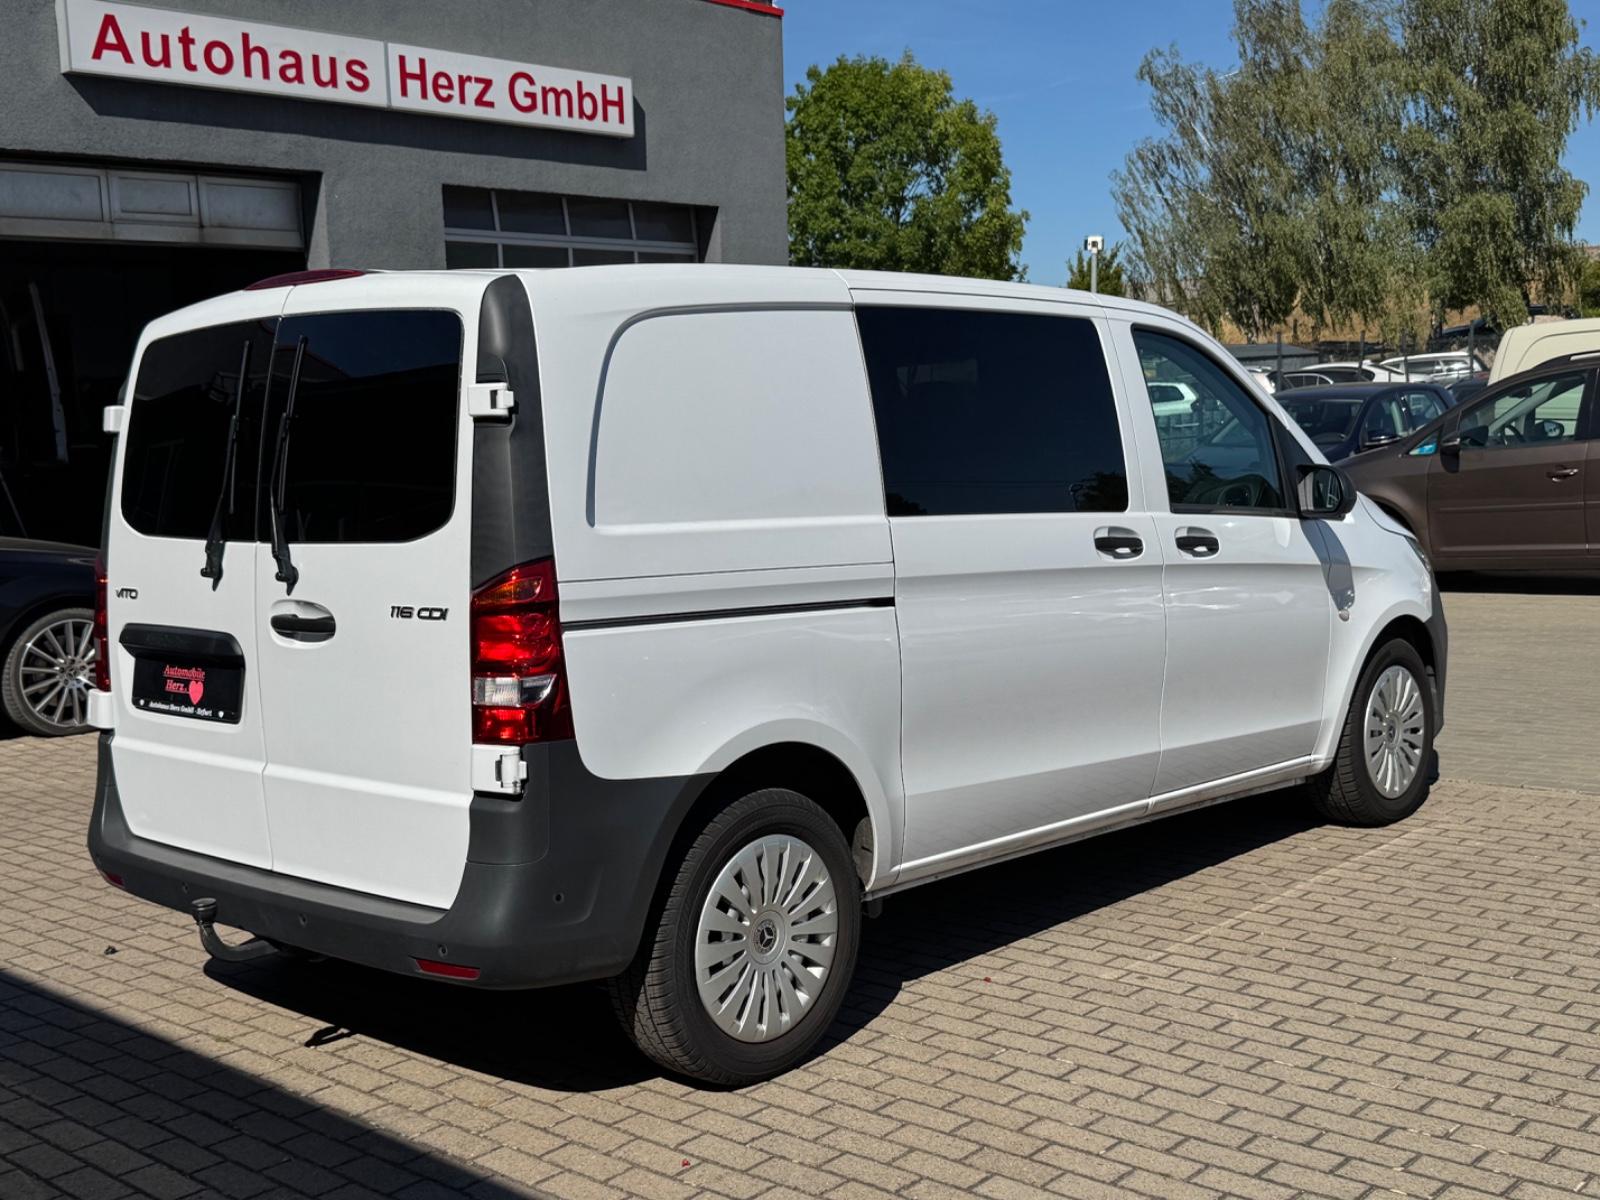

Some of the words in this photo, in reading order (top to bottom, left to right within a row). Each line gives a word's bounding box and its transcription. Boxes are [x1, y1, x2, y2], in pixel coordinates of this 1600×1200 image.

[92, 13, 371, 93] Autohaus
[399, 55, 496, 109] Herz
[508, 71, 626, 124] GmbH
[115, 588, 138, 600] VITO
[391, 605, 414, 619] 116
[417, 607, 449, 621] CDI
